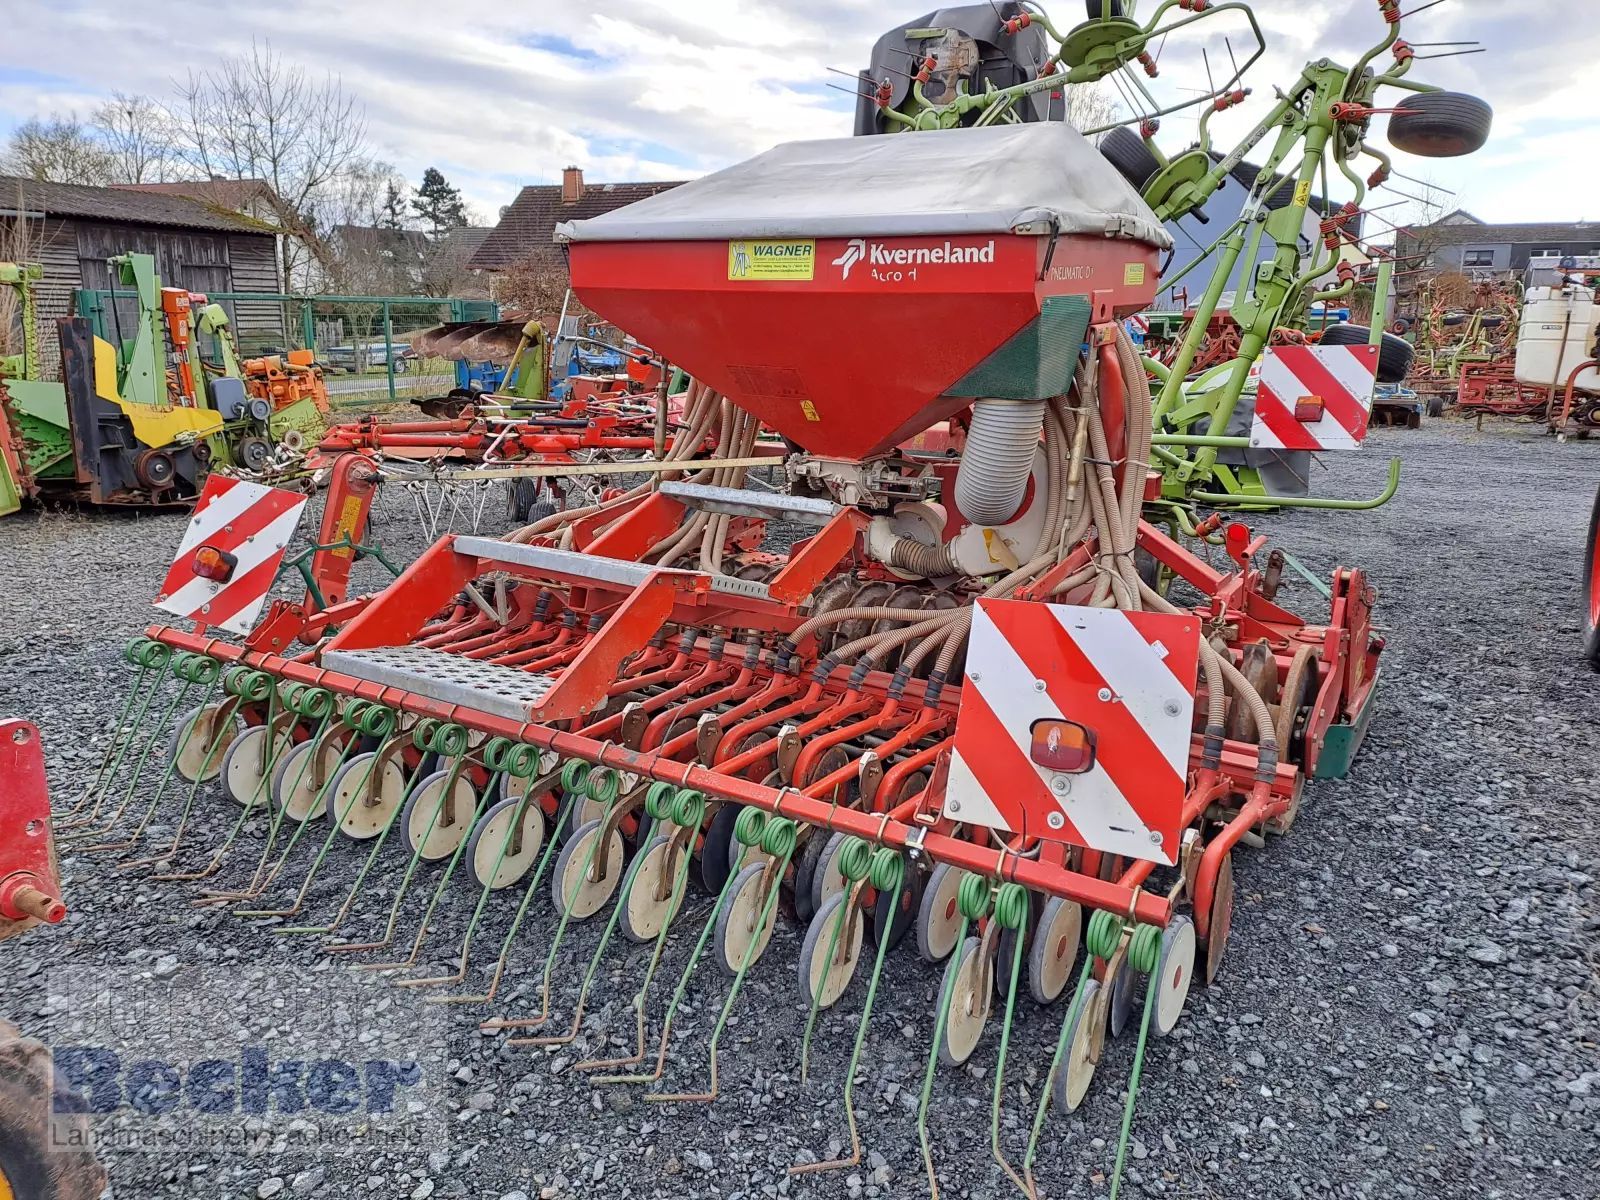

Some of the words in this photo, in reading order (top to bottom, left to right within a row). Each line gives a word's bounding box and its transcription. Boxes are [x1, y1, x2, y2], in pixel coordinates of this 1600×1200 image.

[753, 245, 812, 256] WAGNER
[869, 240, 995, 265] Kverneland
[1051, 265, 1084, 281] PNEUMATIC
